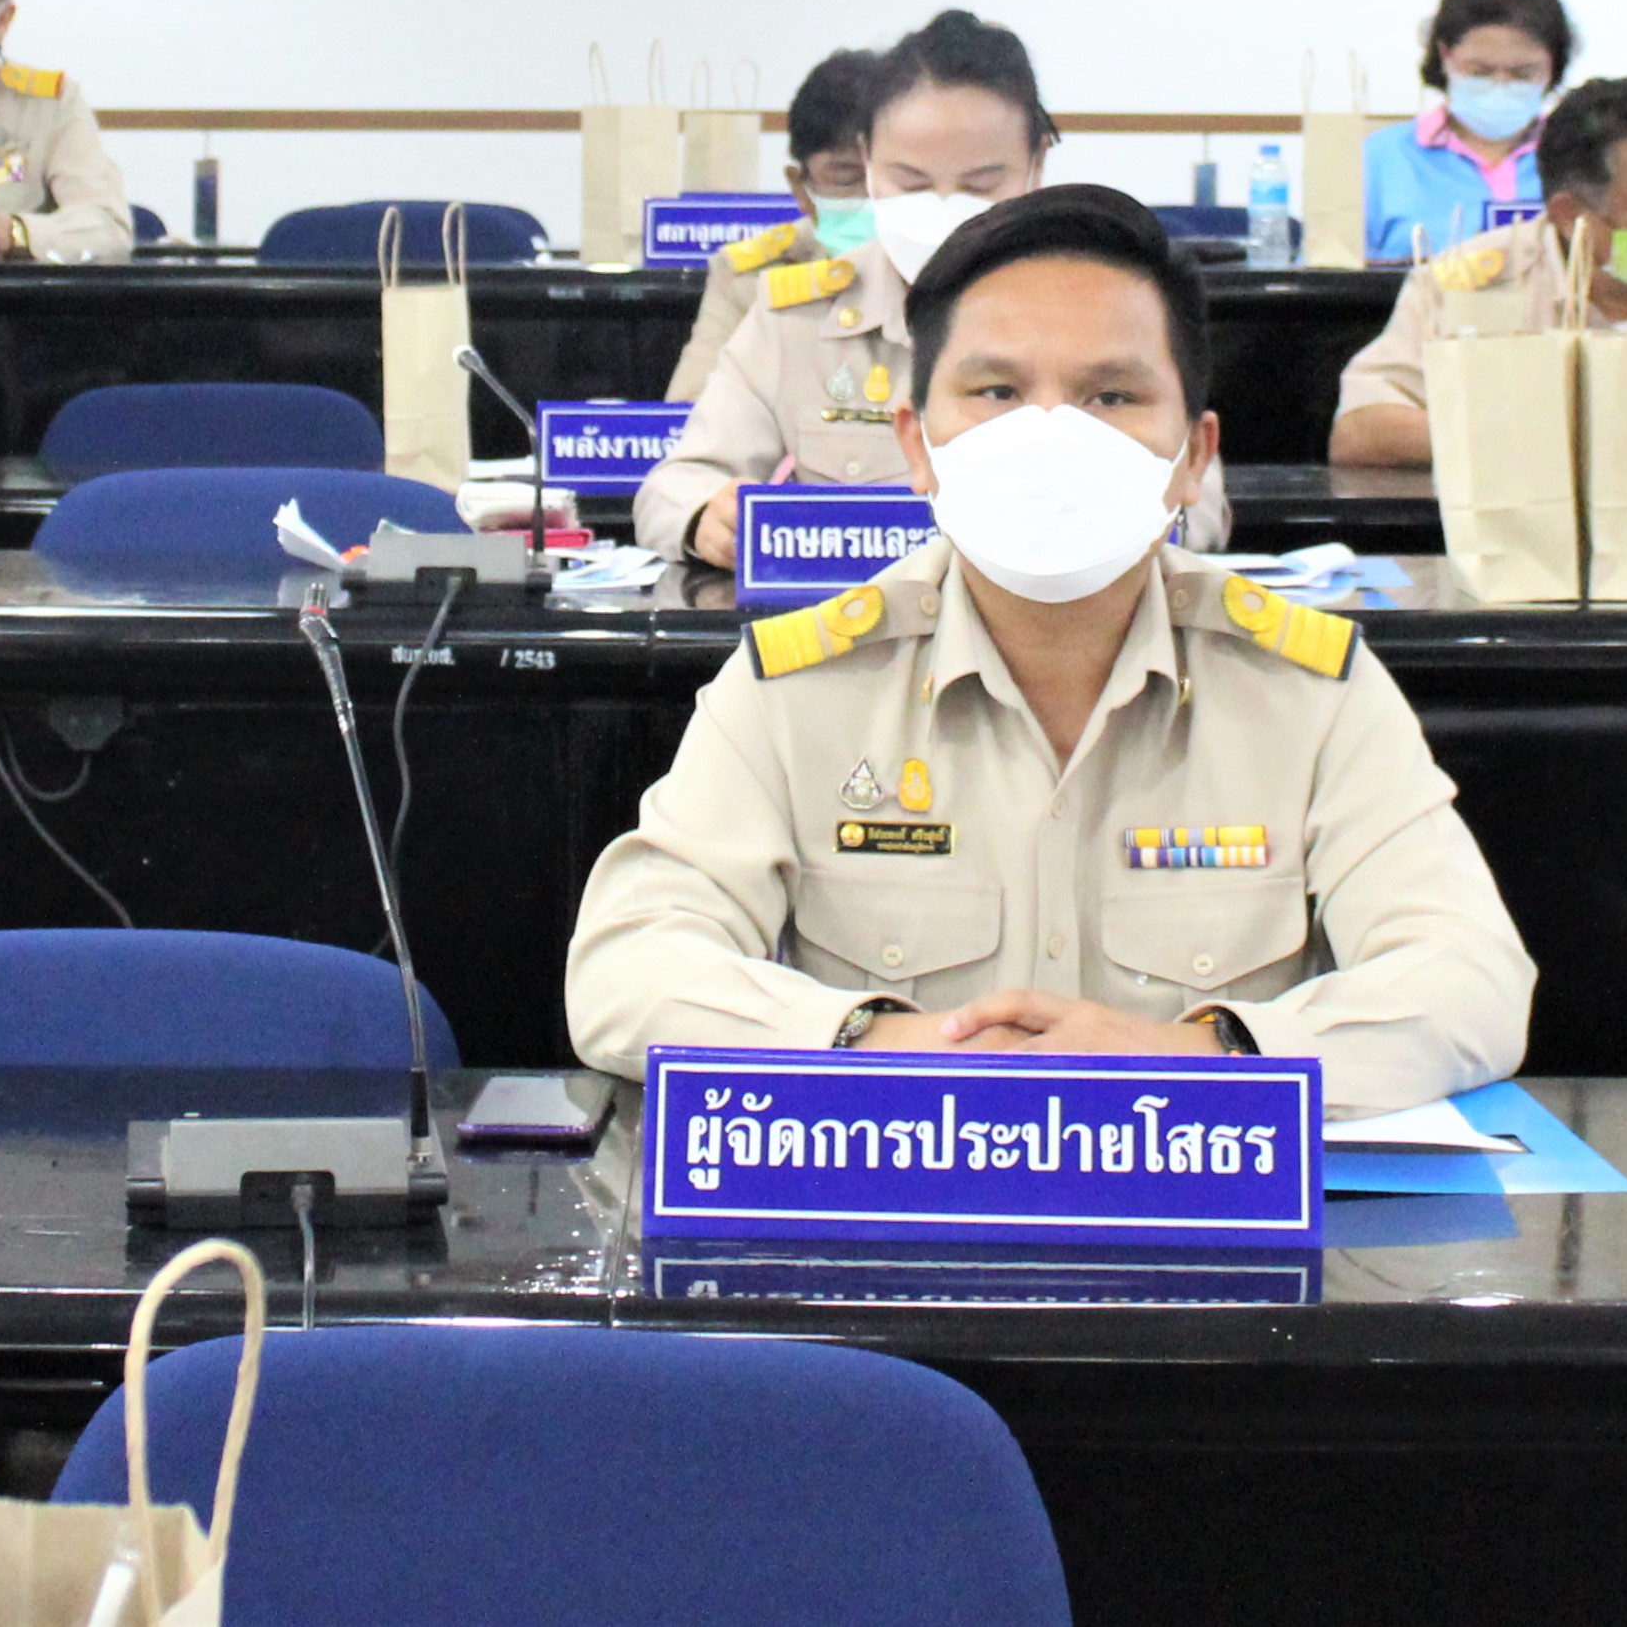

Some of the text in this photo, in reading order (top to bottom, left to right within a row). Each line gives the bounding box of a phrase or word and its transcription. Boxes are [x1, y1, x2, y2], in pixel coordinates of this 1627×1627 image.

[686, 1086, 1277, 1190] ผู้จัดการประปายโสธร
